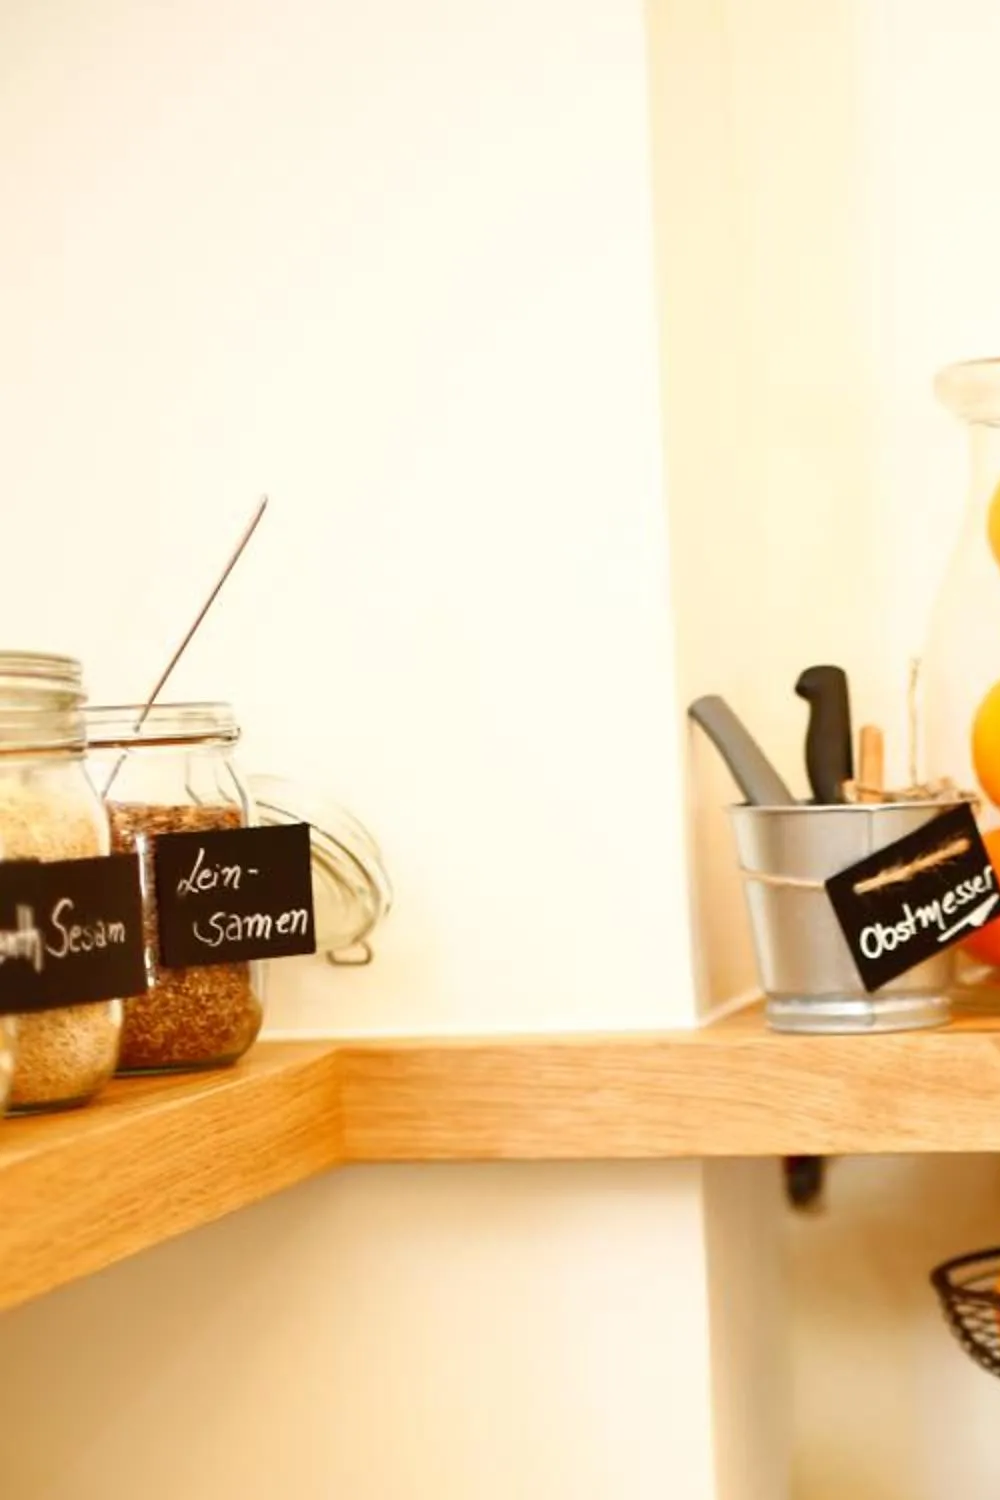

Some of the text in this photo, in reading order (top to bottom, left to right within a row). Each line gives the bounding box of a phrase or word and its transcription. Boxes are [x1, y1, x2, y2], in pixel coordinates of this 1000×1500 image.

[176, 847, 259, 895] Lein-
[45, 897, 126, 958] Sesam
[859, 865, 993, 959] Obstmesser
